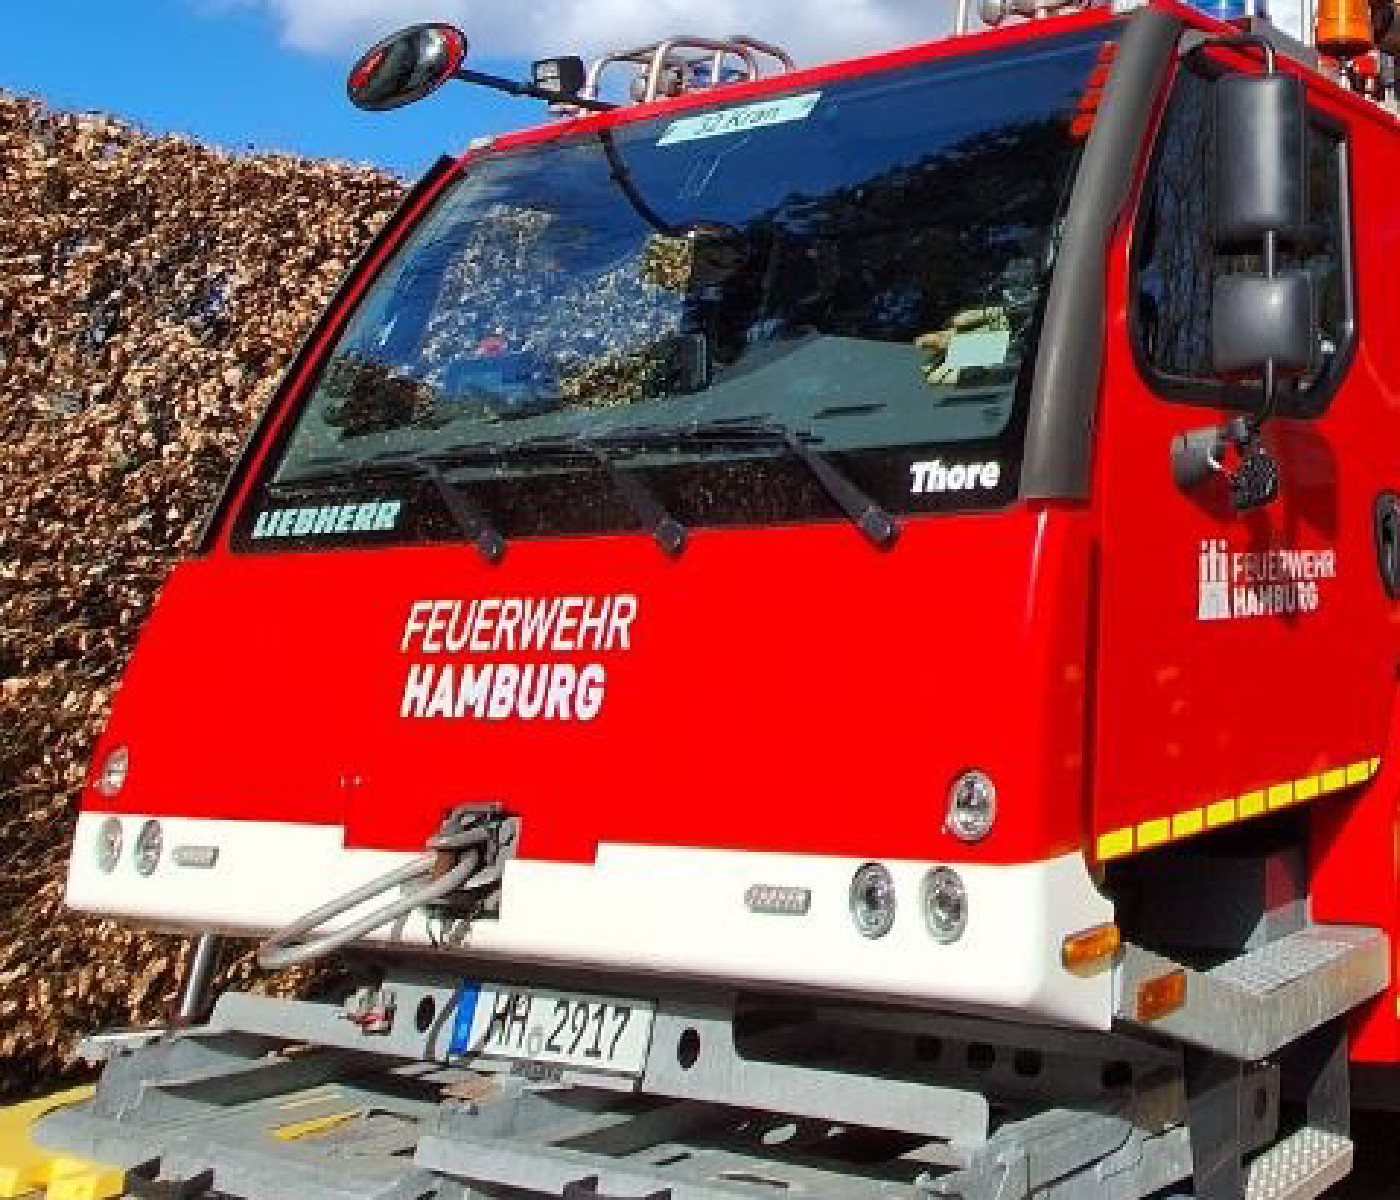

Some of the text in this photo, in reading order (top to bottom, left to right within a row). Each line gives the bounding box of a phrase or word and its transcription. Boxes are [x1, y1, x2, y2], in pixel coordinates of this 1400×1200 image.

[727, 106, 780, 127] Kran
[910, 458, 1000, 492] Thore
[252, 501, 400, 539] LIEBHERR
[1233, 550, 1336, 582] FEUERWEHR
[1233, 580, 1319, 618] HAMBURG
[400, 594, 639, 652] FEUERWEHR
[400, 663, 607, 720] HAMBURG
[545, 1000, 631, 1060] 2917
